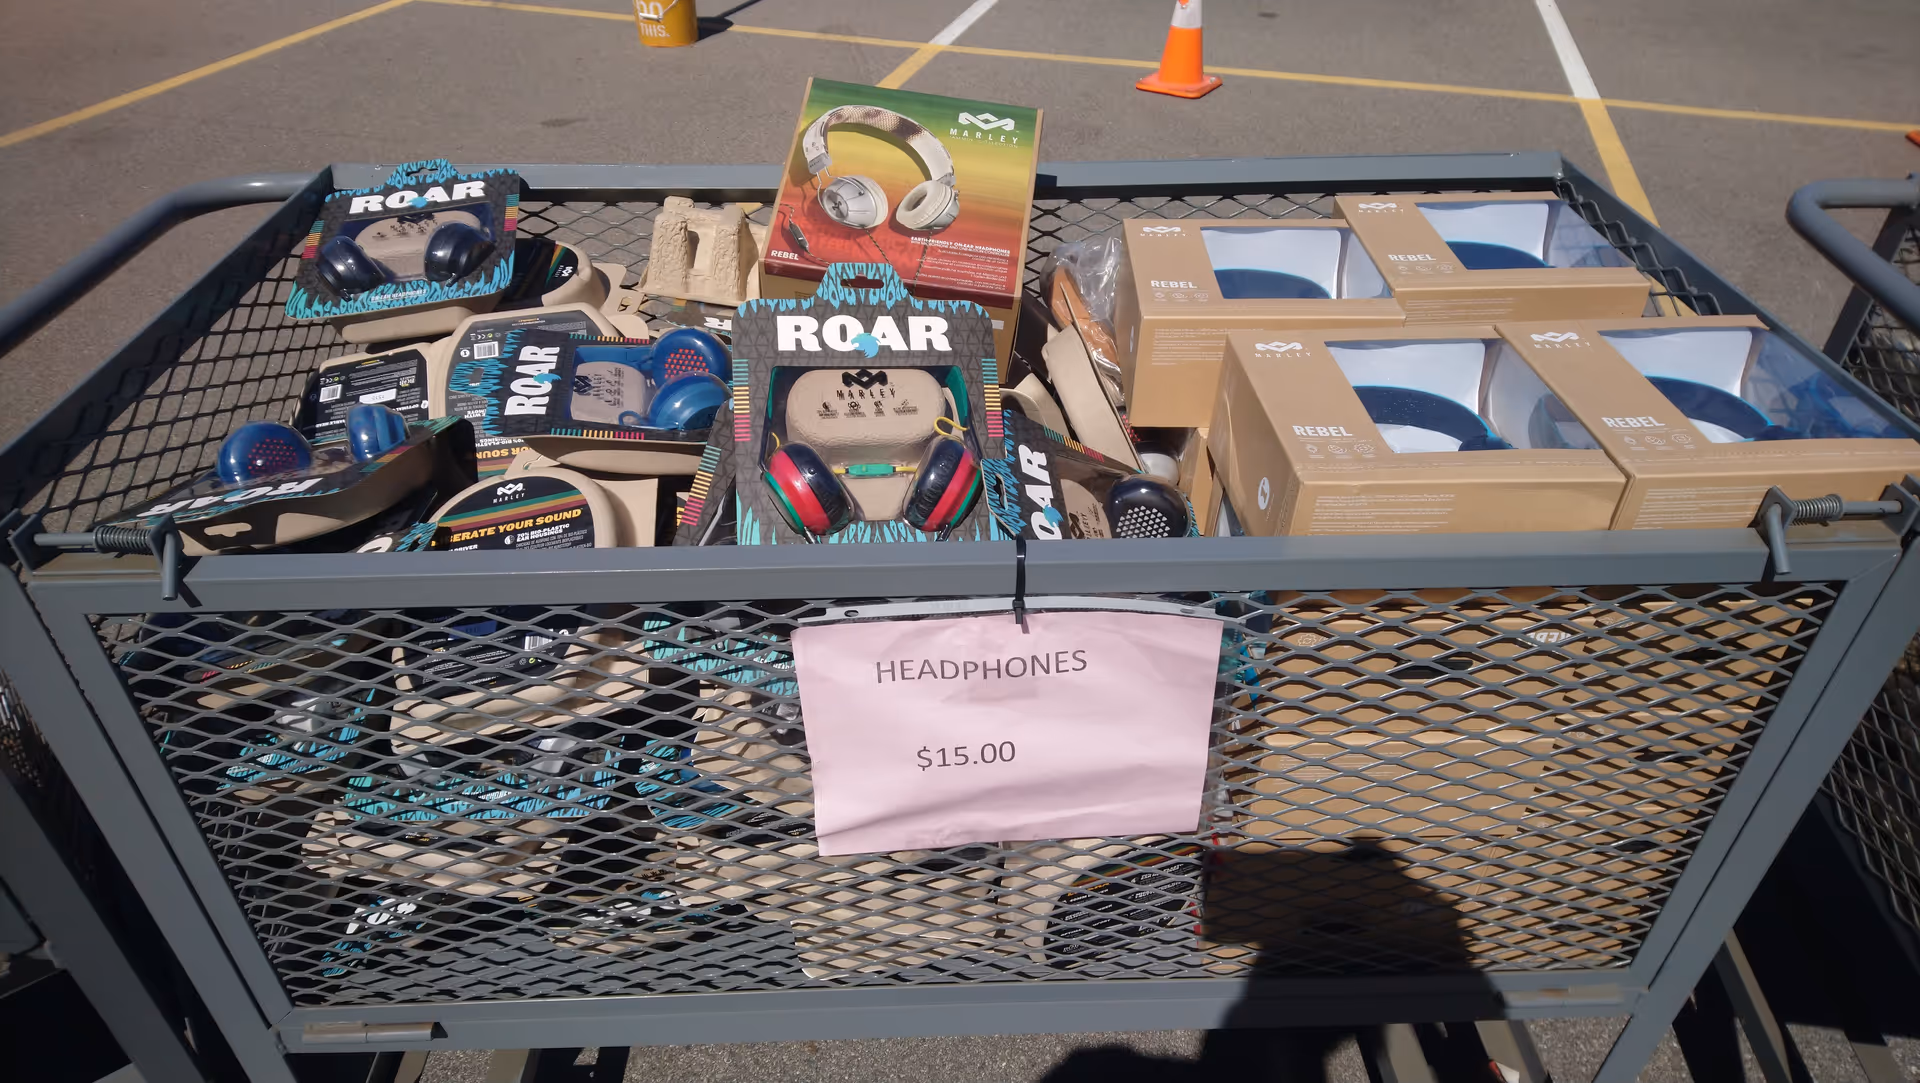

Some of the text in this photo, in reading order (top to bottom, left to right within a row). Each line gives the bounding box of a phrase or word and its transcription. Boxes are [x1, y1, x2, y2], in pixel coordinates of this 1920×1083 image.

[949, 128, 1018, 144] MARLEY
[349, 180, 486, 214] ROAR
[771, 250, 799, 260] REBEL
[1151, 280, 1197, 289] REBEL
[776, 315, 952, 352] ROAR
[504, 345, 560, 416] ROAR
[836, 389, 896, 400] MARLEY
[1292, 425, 1353, 437] REBEL
[1601, 416, 1666, 428] REBEL
[136, 477, 324, 517] ROAR
[493, 493, 526, 504] MARLEY
[1018, 444, 1063, 540] OAR
[449, 509, 582, 543] ERATE YOUR SOUND
[531, 523, 570, 534] BIO-PLASTIC
[875, 649, 1088, 683] HEADPHONES
[916, 741, 1016, 771] $15.00
